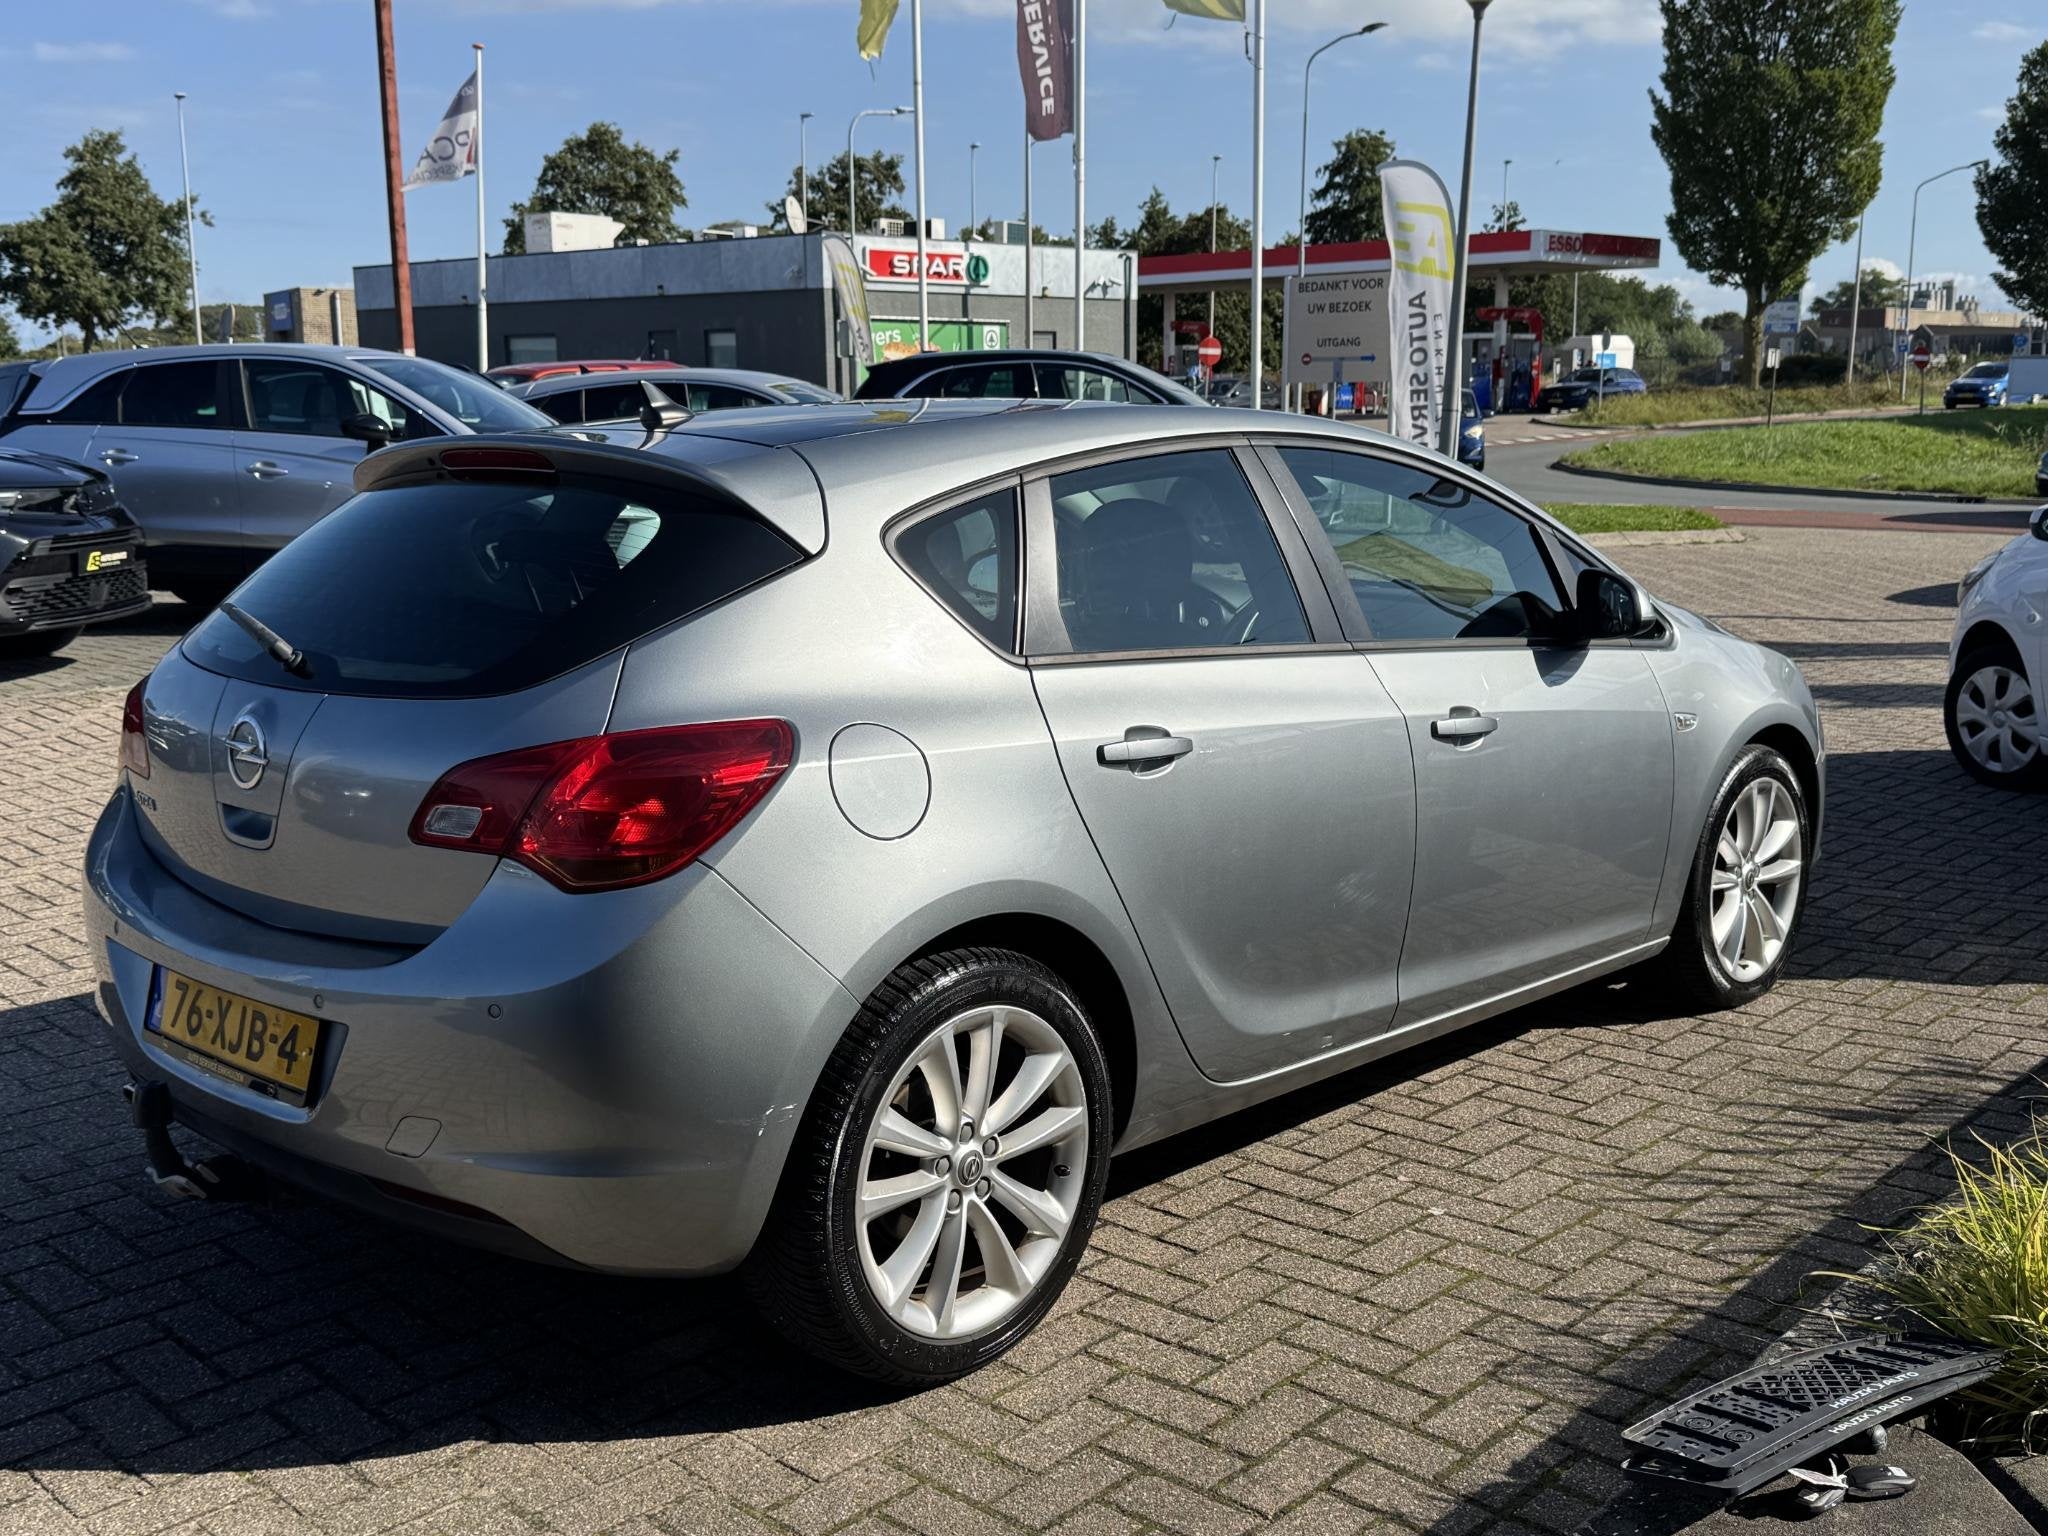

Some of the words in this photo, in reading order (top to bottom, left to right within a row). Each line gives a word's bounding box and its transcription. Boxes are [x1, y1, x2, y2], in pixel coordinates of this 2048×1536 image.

[1548, 234, 1582, 253] ESSO
[1298, 279, 1350, 293] BEDANKT
[1351, 278, 1384, 290] VOOR
[1308, 303, 1326, 314] UW
[1329, 300, 1372, 313] BEZOEK
[1316, 336, 1361, 348] UITGANG
[170, 978, 300, 1075] 76-XJB-4
[1829, 1387, 1878, 1409] HAVIK
[1883, 1371, 1919, 1386] AUTO
[1828, 1412, 1875, 1434] HAVIK
[1879, 1395, 1913, 1412] AUTO
